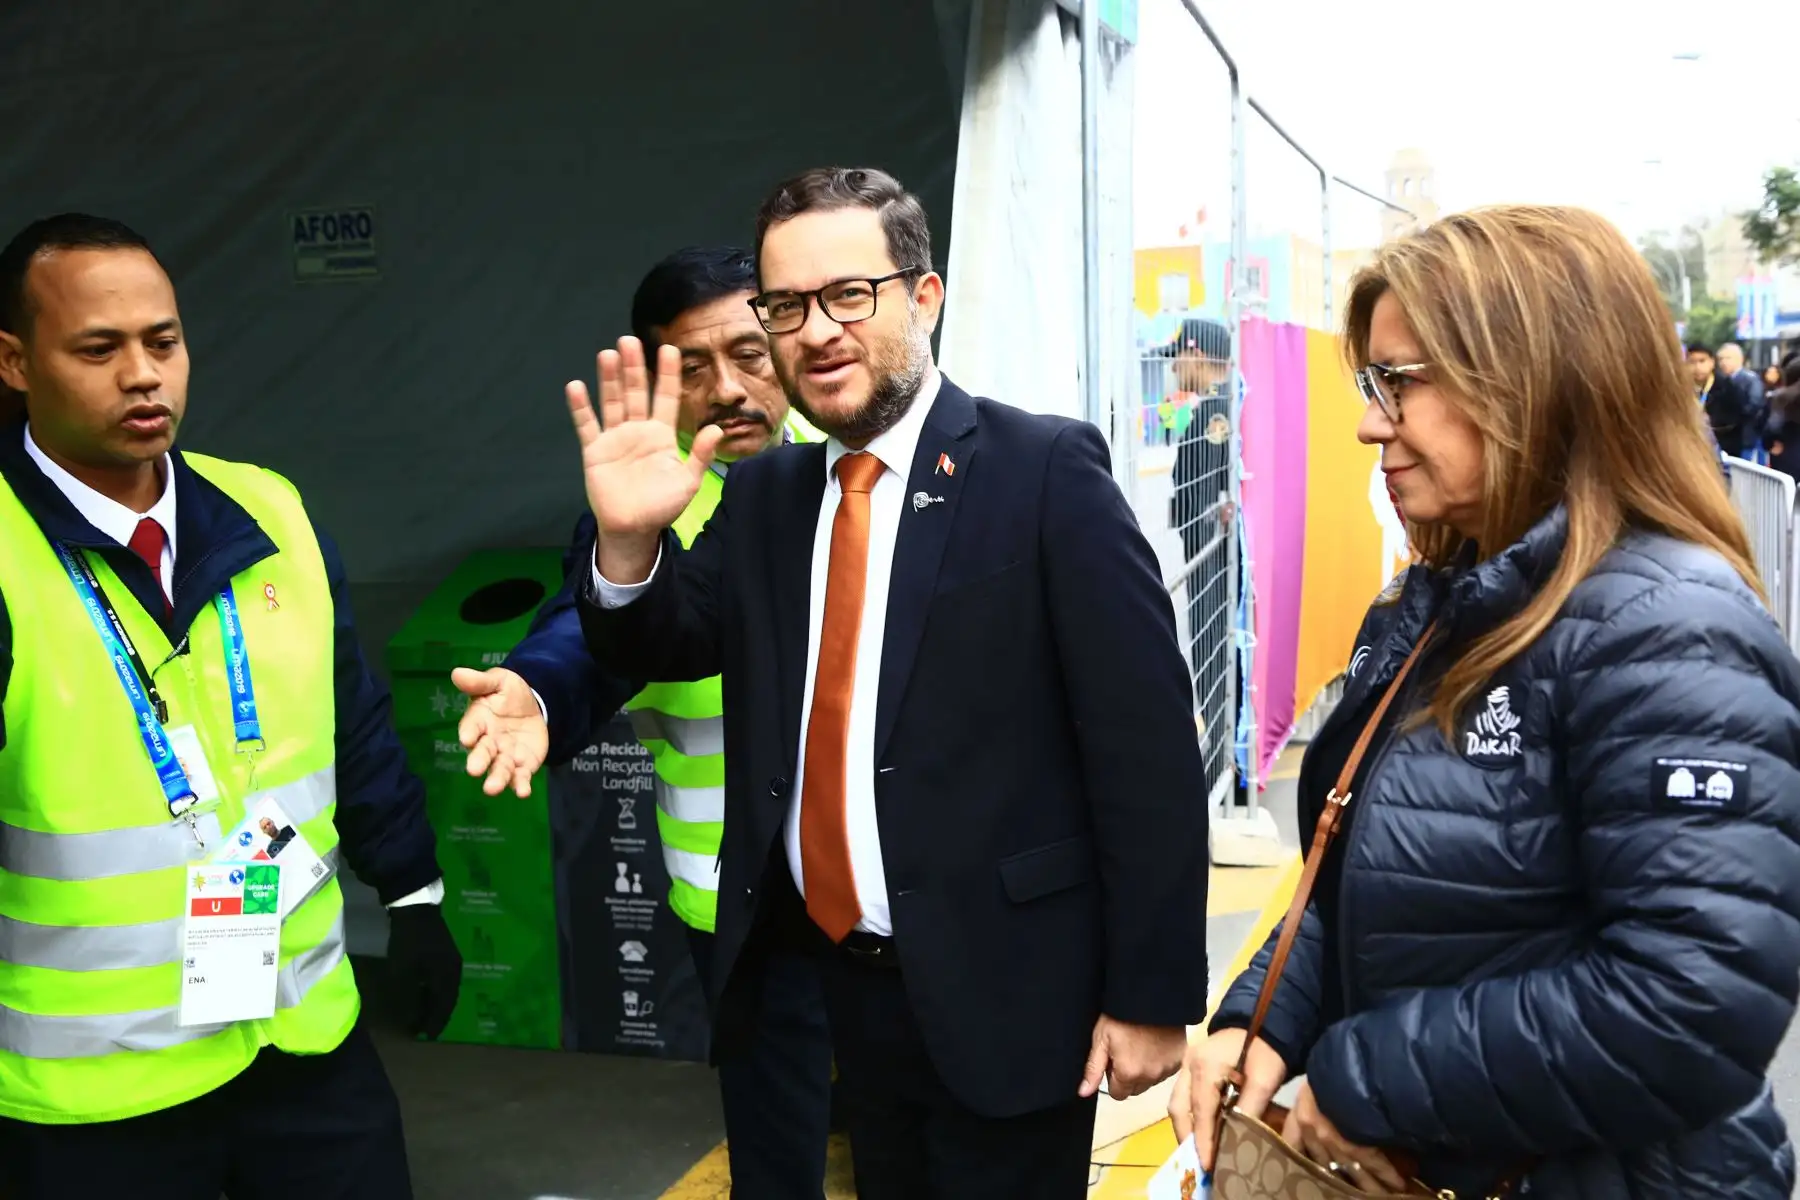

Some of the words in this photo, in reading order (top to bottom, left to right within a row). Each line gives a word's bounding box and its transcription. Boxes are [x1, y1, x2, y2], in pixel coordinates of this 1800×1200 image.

[294, 211, 372, 244] AFORO
[601, 742, 650, 755] Recicla
[1466, 731, 1523, 757] DAKAR
[572, 757, 600, 772] Non
[603, 758, 654, 776] Recycla
[602, 775, 654, 794] Landfill
[211, 900, 221, 912] U
